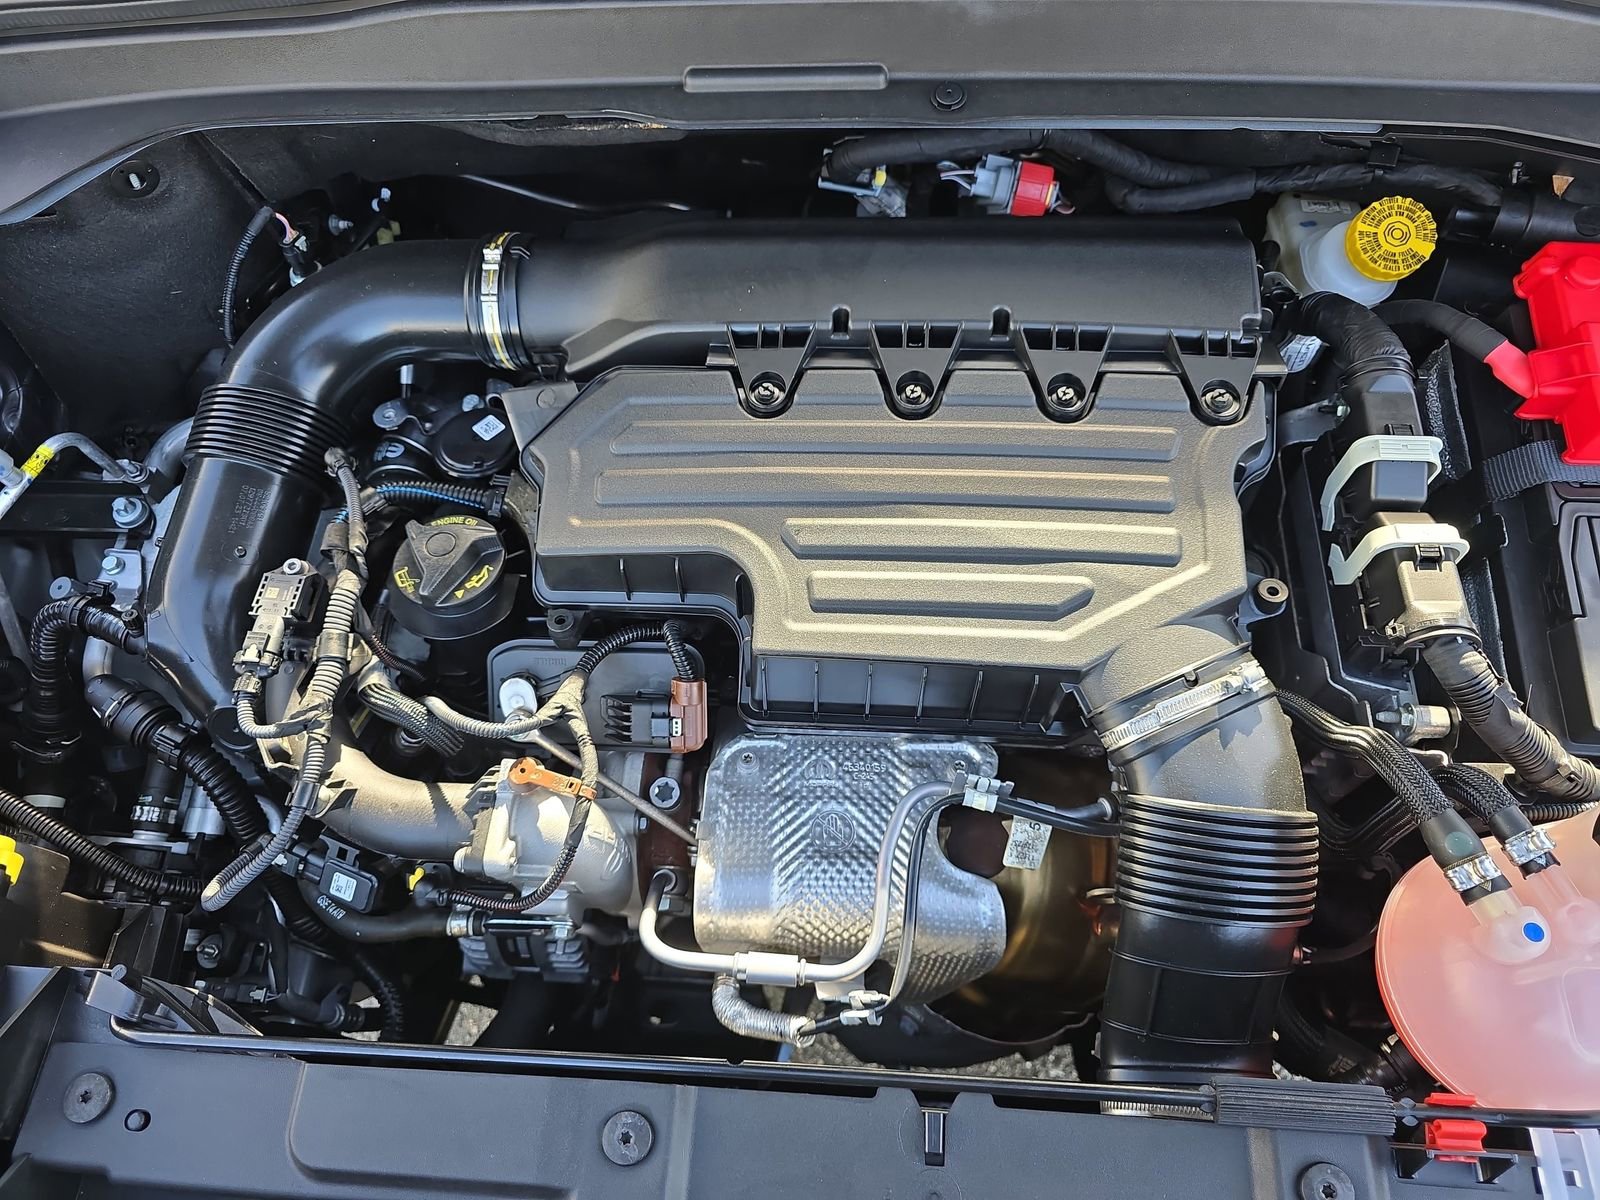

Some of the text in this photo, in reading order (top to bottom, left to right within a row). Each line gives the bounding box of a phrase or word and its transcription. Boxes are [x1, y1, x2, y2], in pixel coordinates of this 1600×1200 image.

[1383, 249, 1396, 258] CLEAN
[1398, 247, 1414, 258] FILLER
[1367, 254, 1379, 265] FROM
[431, 517, 465, 526] ENGINE
